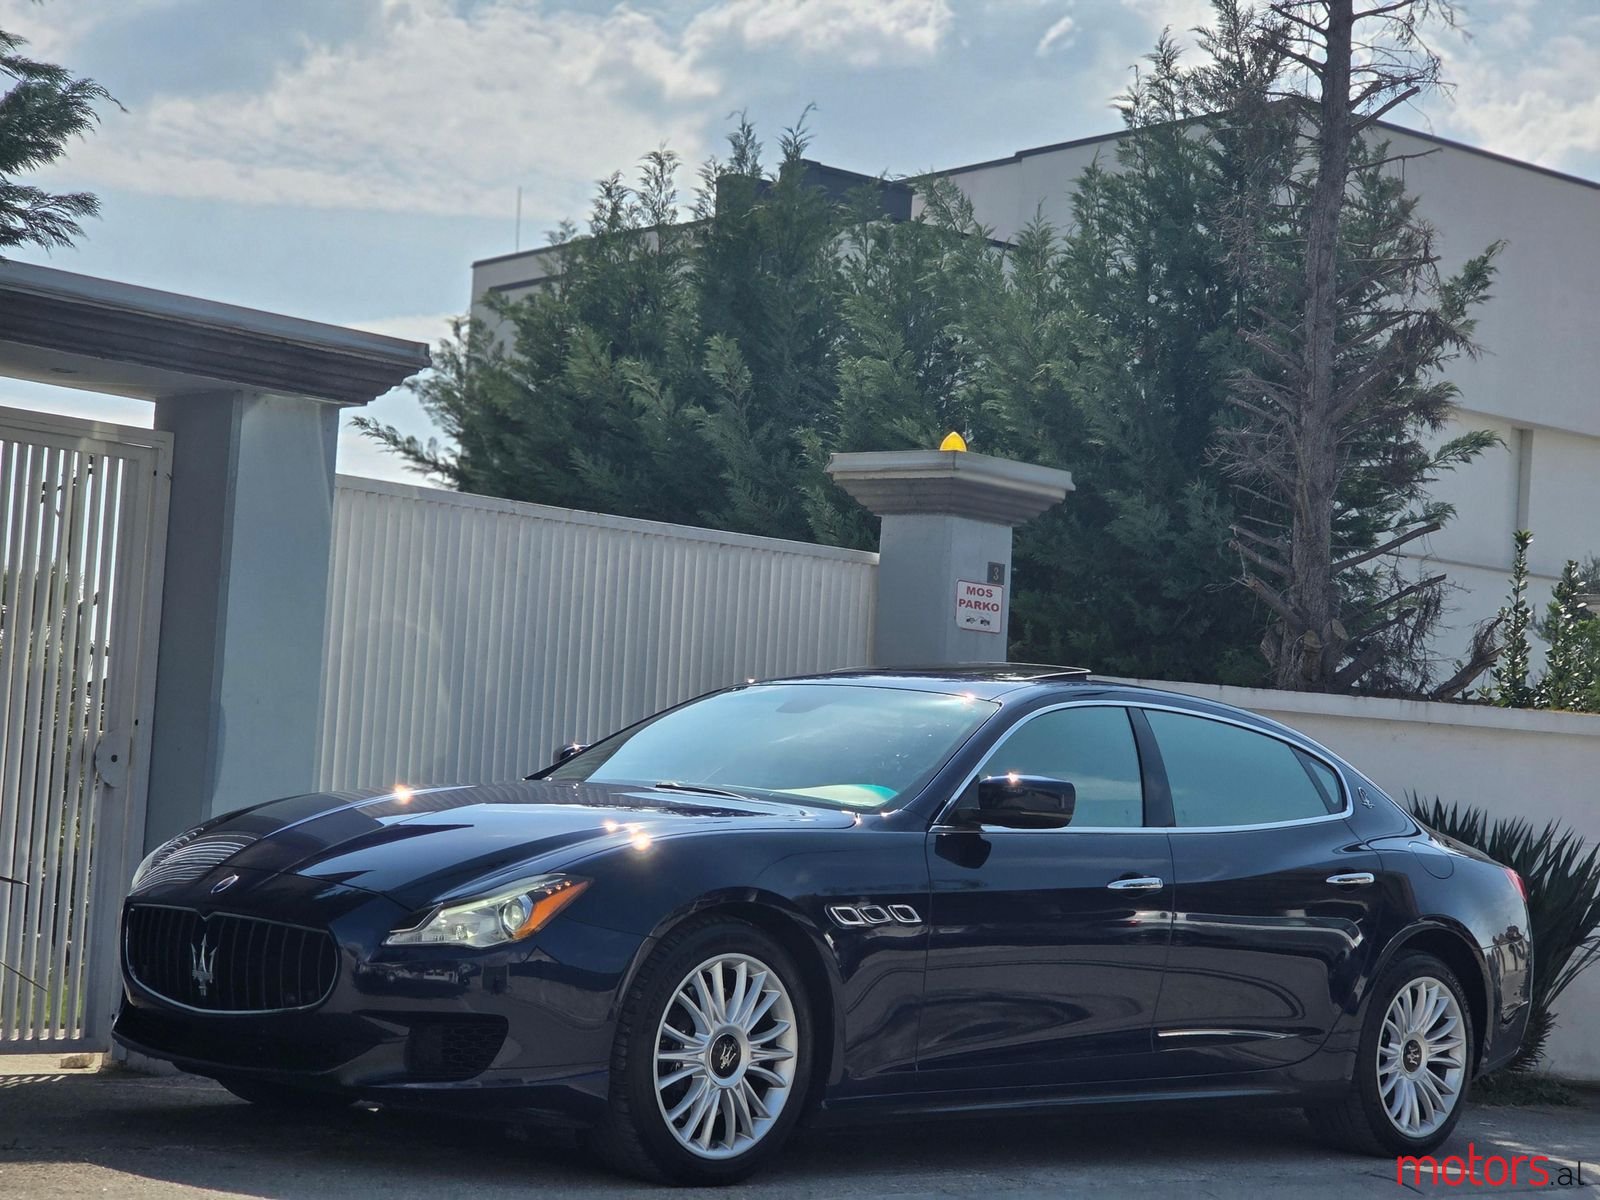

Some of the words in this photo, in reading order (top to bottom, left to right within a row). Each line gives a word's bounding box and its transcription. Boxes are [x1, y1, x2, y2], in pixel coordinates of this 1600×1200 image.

[993, 567, 999, 580] 3
[966, 586, 993, 598] MOS
[958, 599, 999, 612] PARKO
